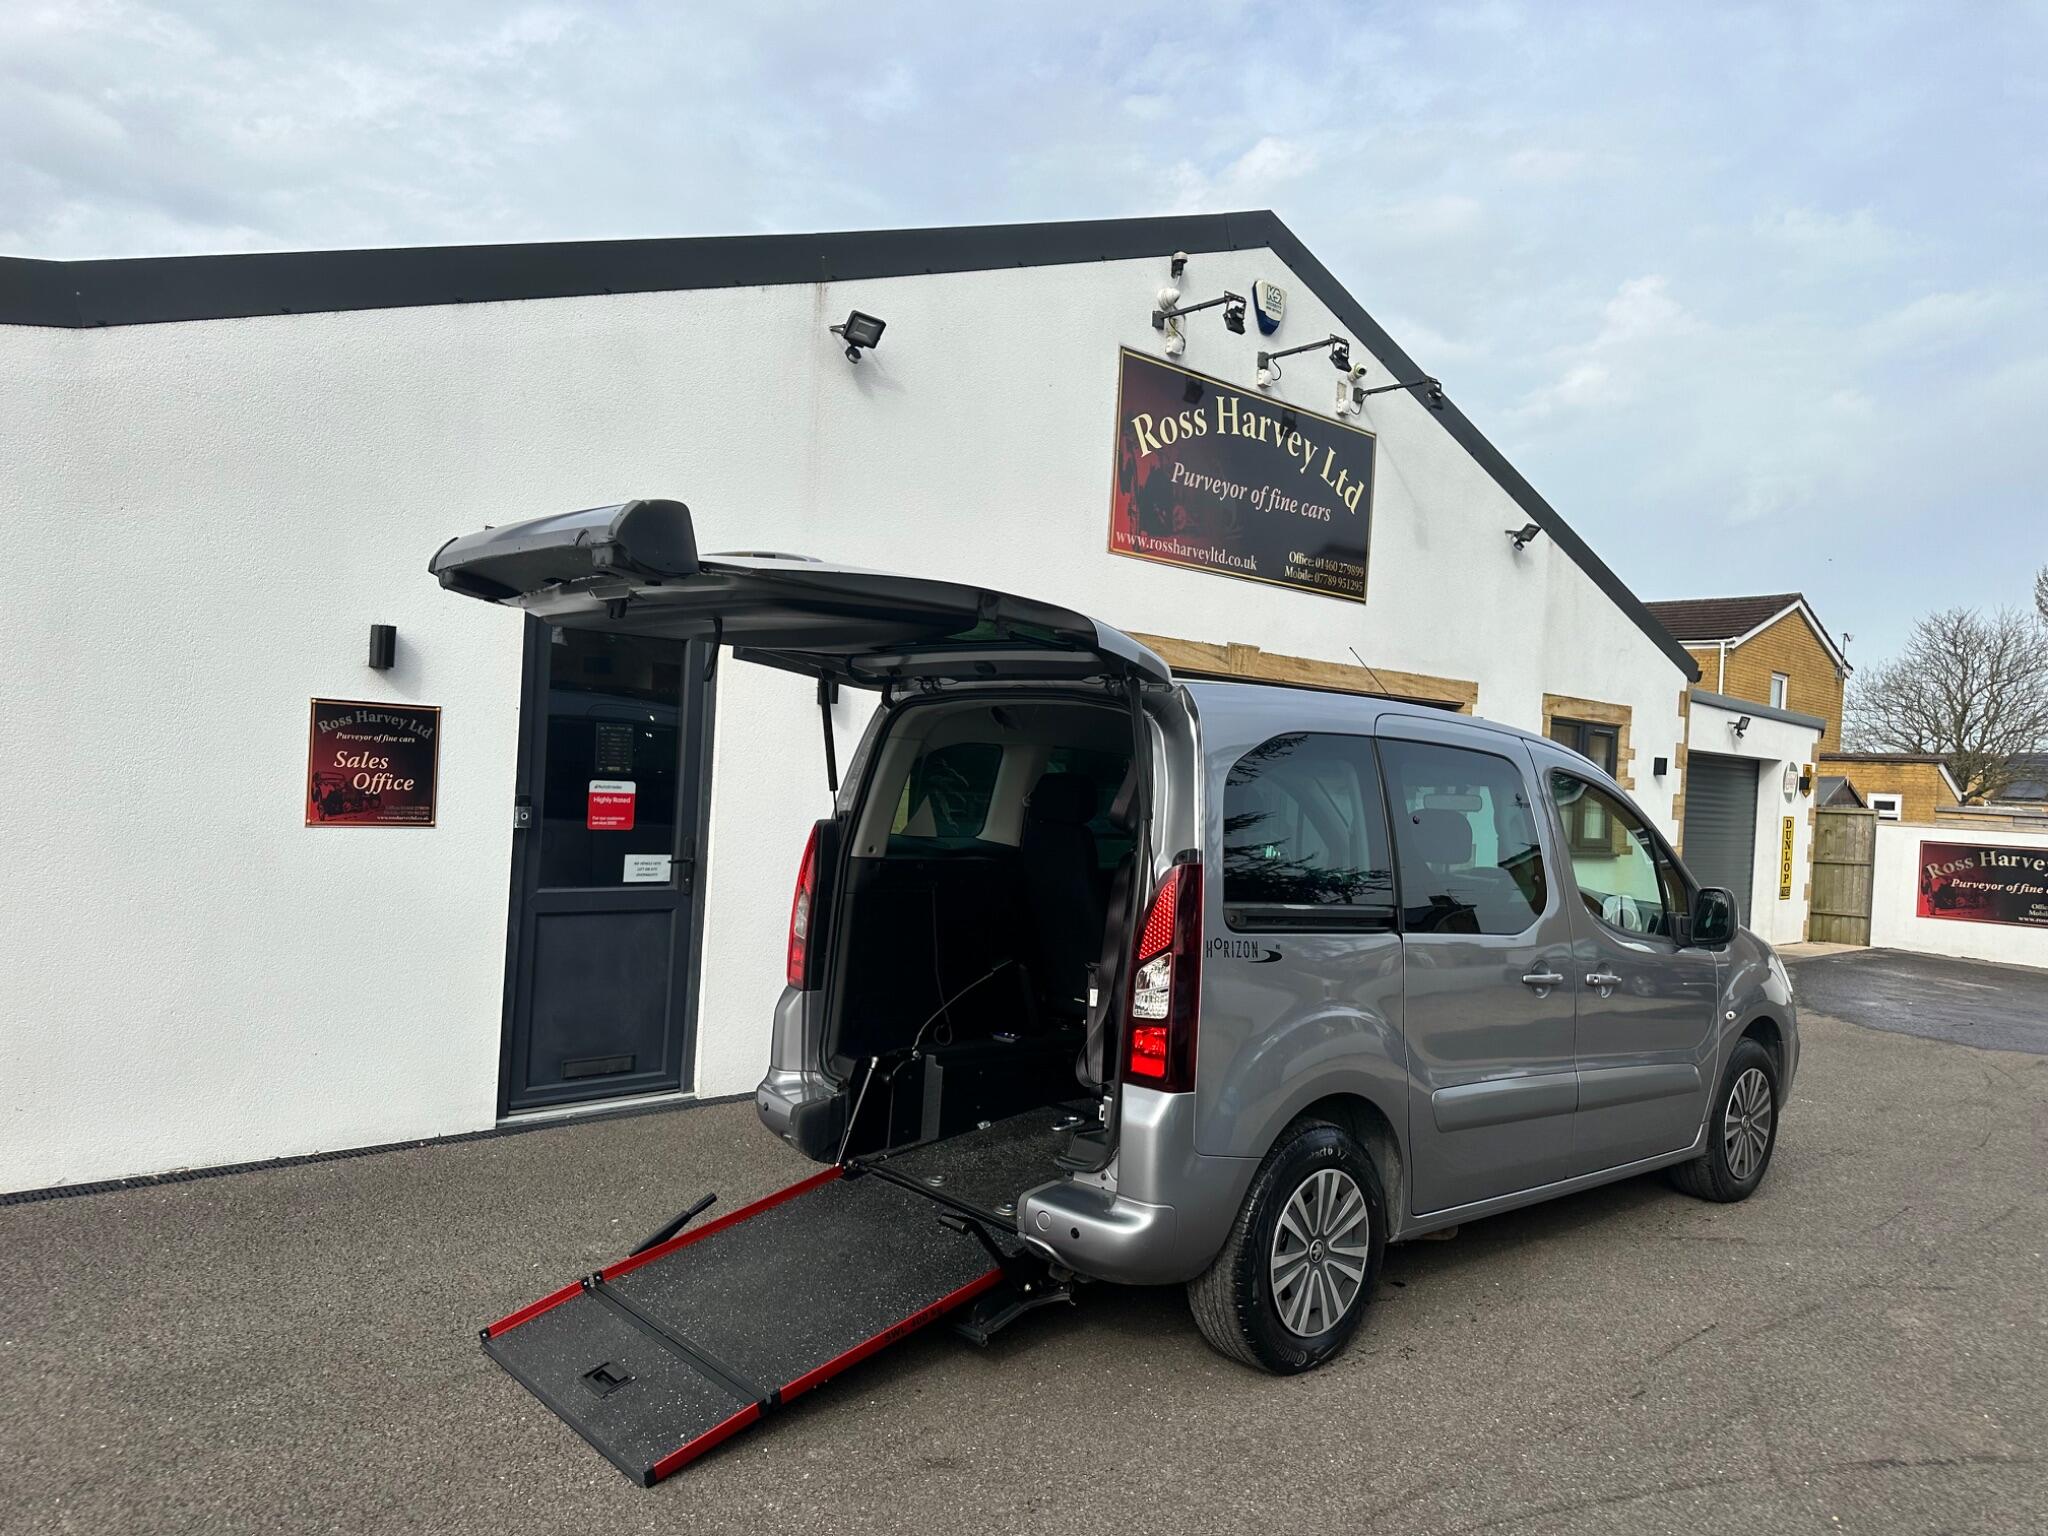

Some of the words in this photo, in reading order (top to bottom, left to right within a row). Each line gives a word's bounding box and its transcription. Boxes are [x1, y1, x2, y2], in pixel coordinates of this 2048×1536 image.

[1131, 408, 1207, 458] Ross
[1215, 395, 1318, 474] Harvey
[1319, 446, 1364, 515] Ltd
[1171, 462, 1248, 501] Purveyor
[1250, 485, 1270, 510] of
[1265, 488, 1298, 513] fine
[1301, 502, 1331, 522] cars
[1116, 531, 1257, 570] www.rossharveyltd.co.uk
[1315, 558, 1338, 572] 01460
[318, 715, 353, 734] Ross
[355, 710, 407, 729] Harvey
[408, 719, 434, 740] Ltd
[333, 750, 389, 769] Sales
[352, 772, 415, 795] Office
[1783, 819, 1792, 883] DUNLOP
[1926, 857, 1974, 880] Ross
[1950, 878, 2005, 892] Purveyor
[2006, 883, 2020, 894] of
[2017, 883, 2044, 895] fine
